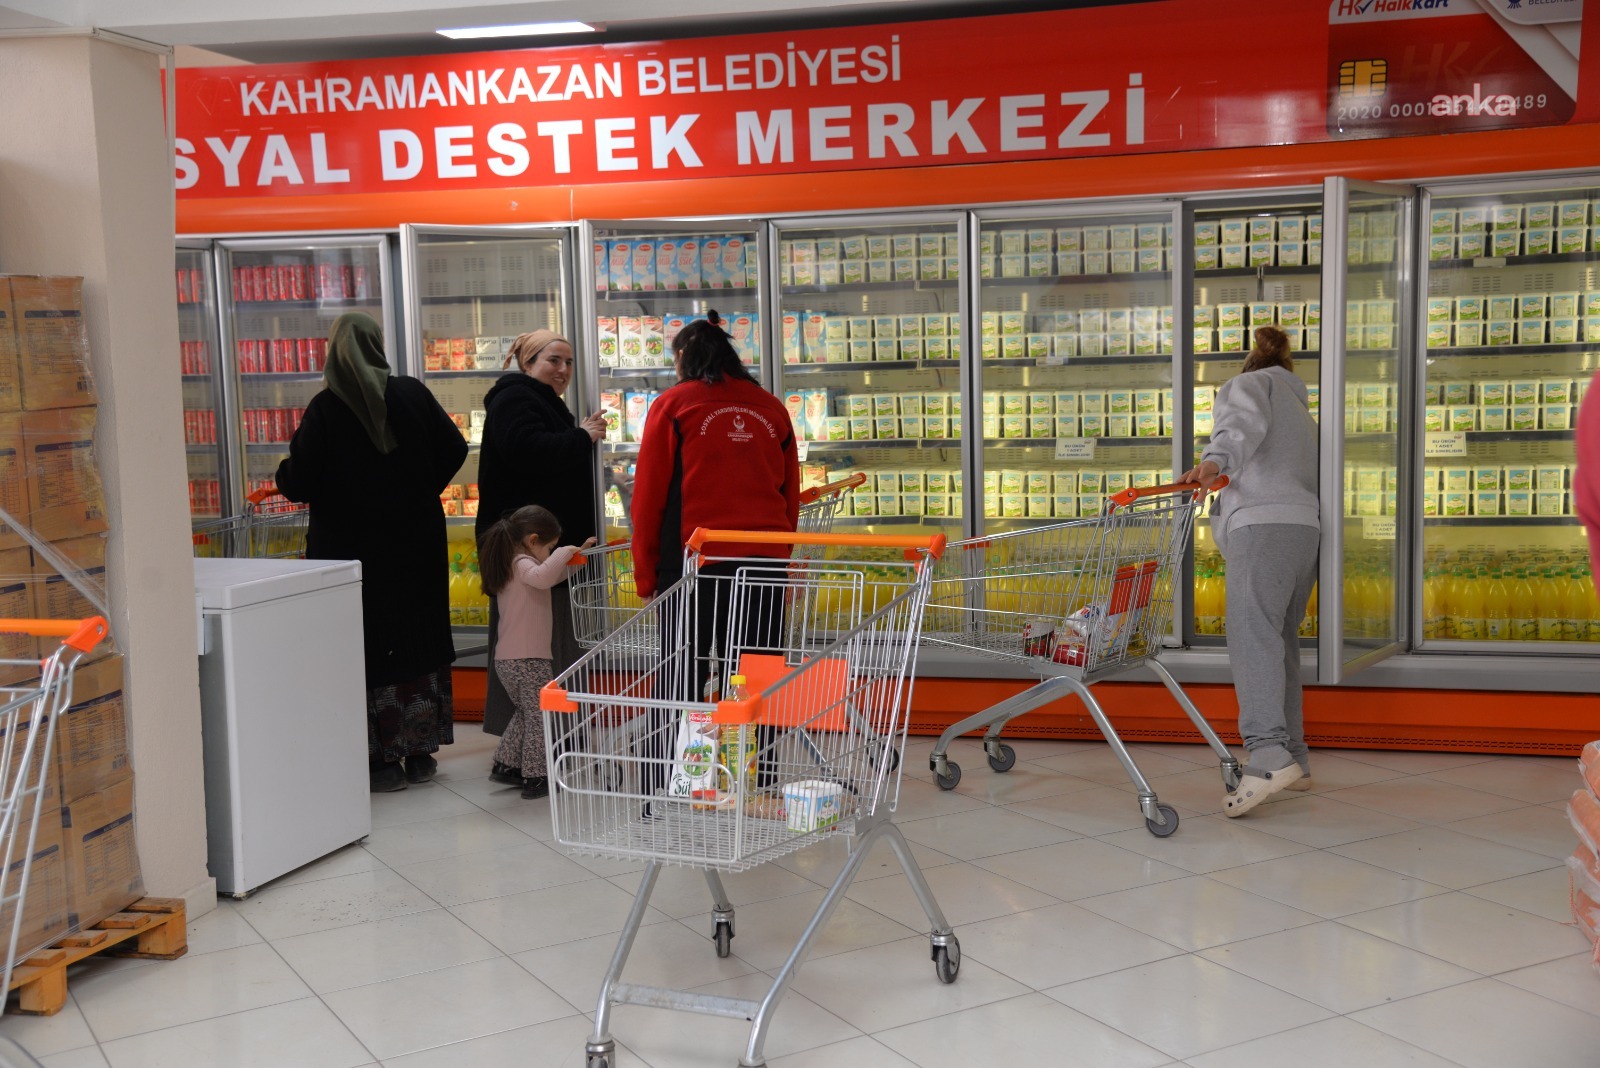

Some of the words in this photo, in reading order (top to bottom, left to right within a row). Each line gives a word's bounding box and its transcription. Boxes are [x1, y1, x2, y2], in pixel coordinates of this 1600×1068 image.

[239, 62, 622, 116] KAHRAMANKAZAN
[637, 34, 901, 97] BELEDİYESİ
[1338, 105, 1382, 120] 2020
[1389, 102, 1433, 118] 0001
[378, 114, 704, 181] DESTEK
[736, 72, 1146, 166] MERKEZİ
